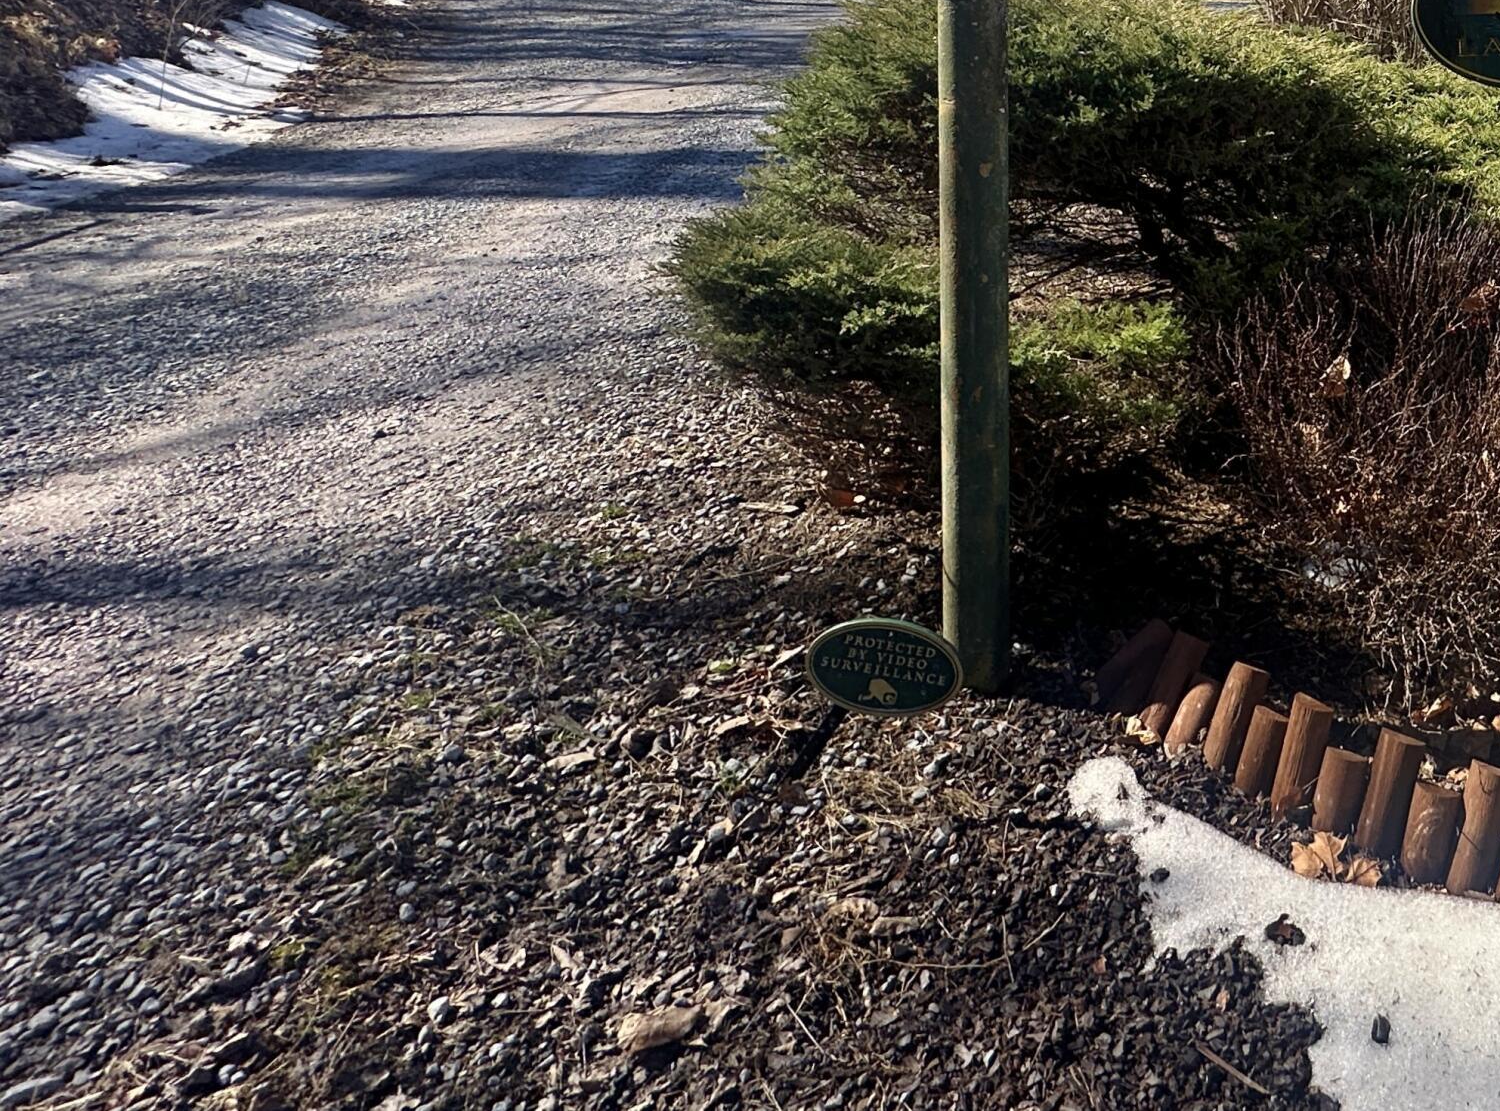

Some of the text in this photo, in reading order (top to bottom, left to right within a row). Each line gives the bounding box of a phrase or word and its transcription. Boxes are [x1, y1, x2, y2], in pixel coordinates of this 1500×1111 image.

[844, 634, 936, 658] PROTECTED
[848, 647, 928, 670] BY VIDEO
[820, 656, 947, 686] SURVEILLANCE
